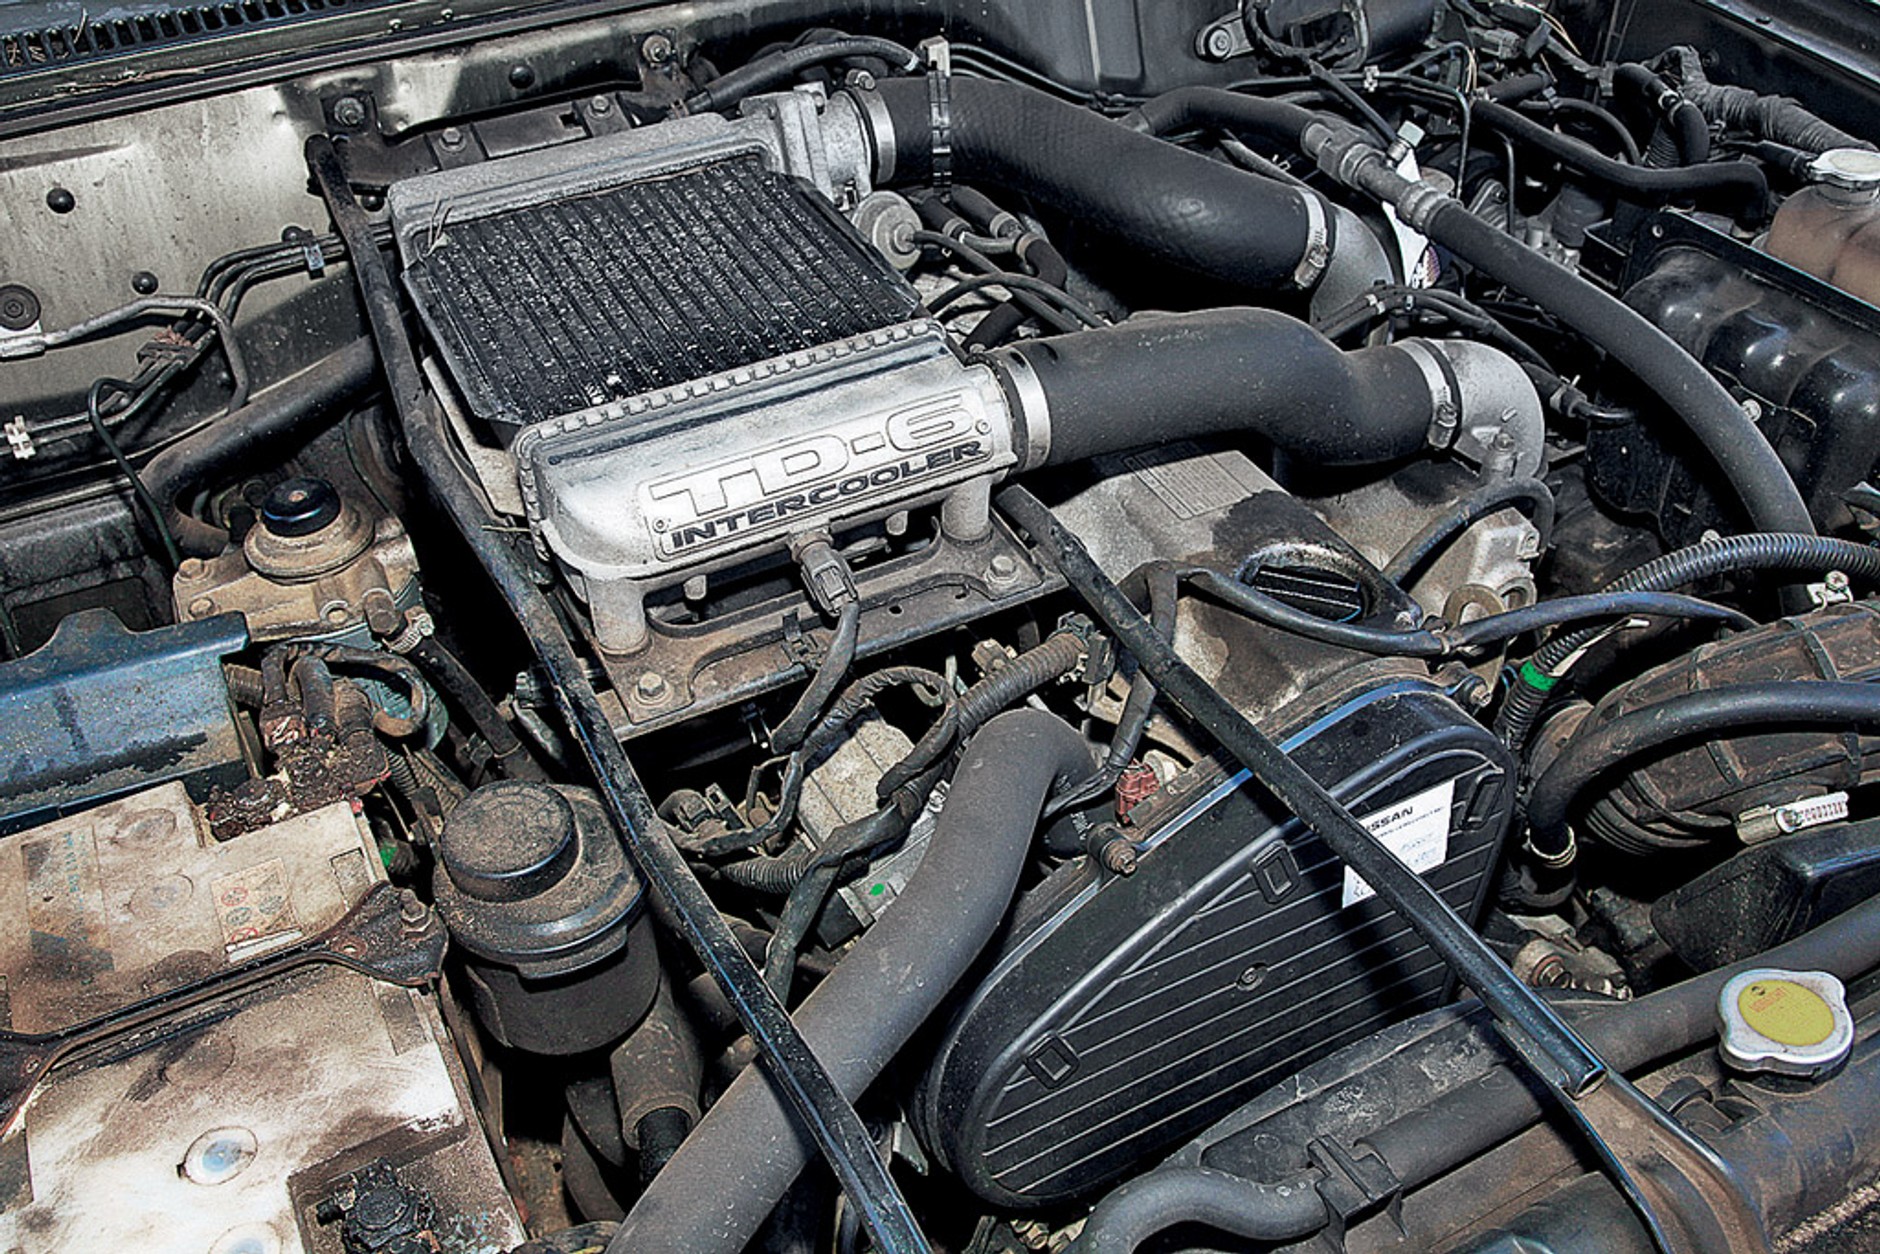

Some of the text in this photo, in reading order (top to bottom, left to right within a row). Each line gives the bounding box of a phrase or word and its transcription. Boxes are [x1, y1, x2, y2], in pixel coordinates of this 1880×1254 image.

[650, 394, 976, 517] TD-6
[671, 440, 983, 549] INTERCOOLER
[1366, 806, 1413, 832] ISSAN
